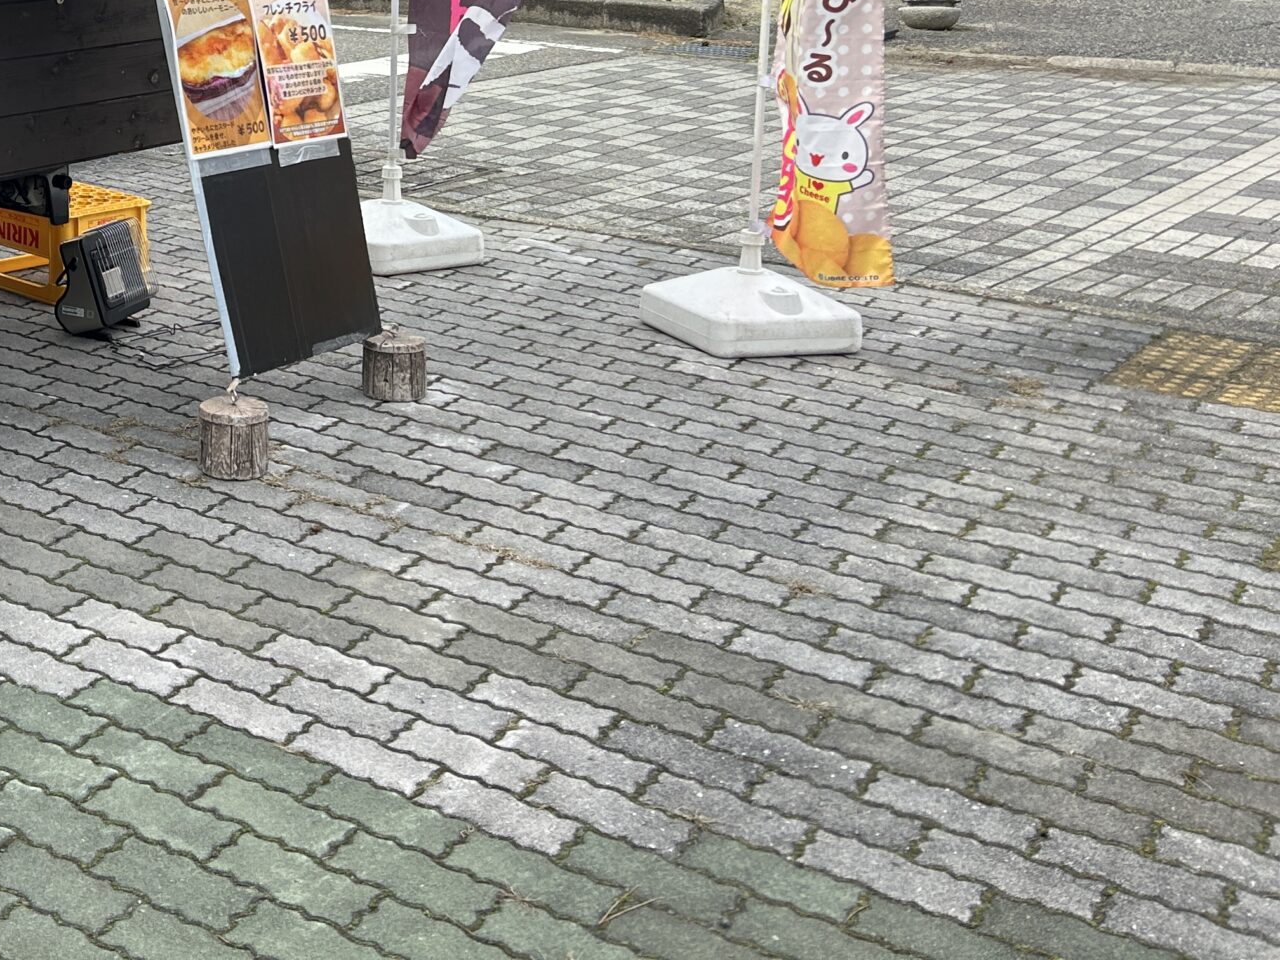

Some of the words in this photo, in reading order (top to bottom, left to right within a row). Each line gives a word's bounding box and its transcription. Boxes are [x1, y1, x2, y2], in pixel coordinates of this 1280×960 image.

[262, 0, 316, 15] フレンチフライ
[288, 24, 326, 42] ¥500
[237, 120, 265, 135] ¥500
[799, 185, 830, 203] Cheese
